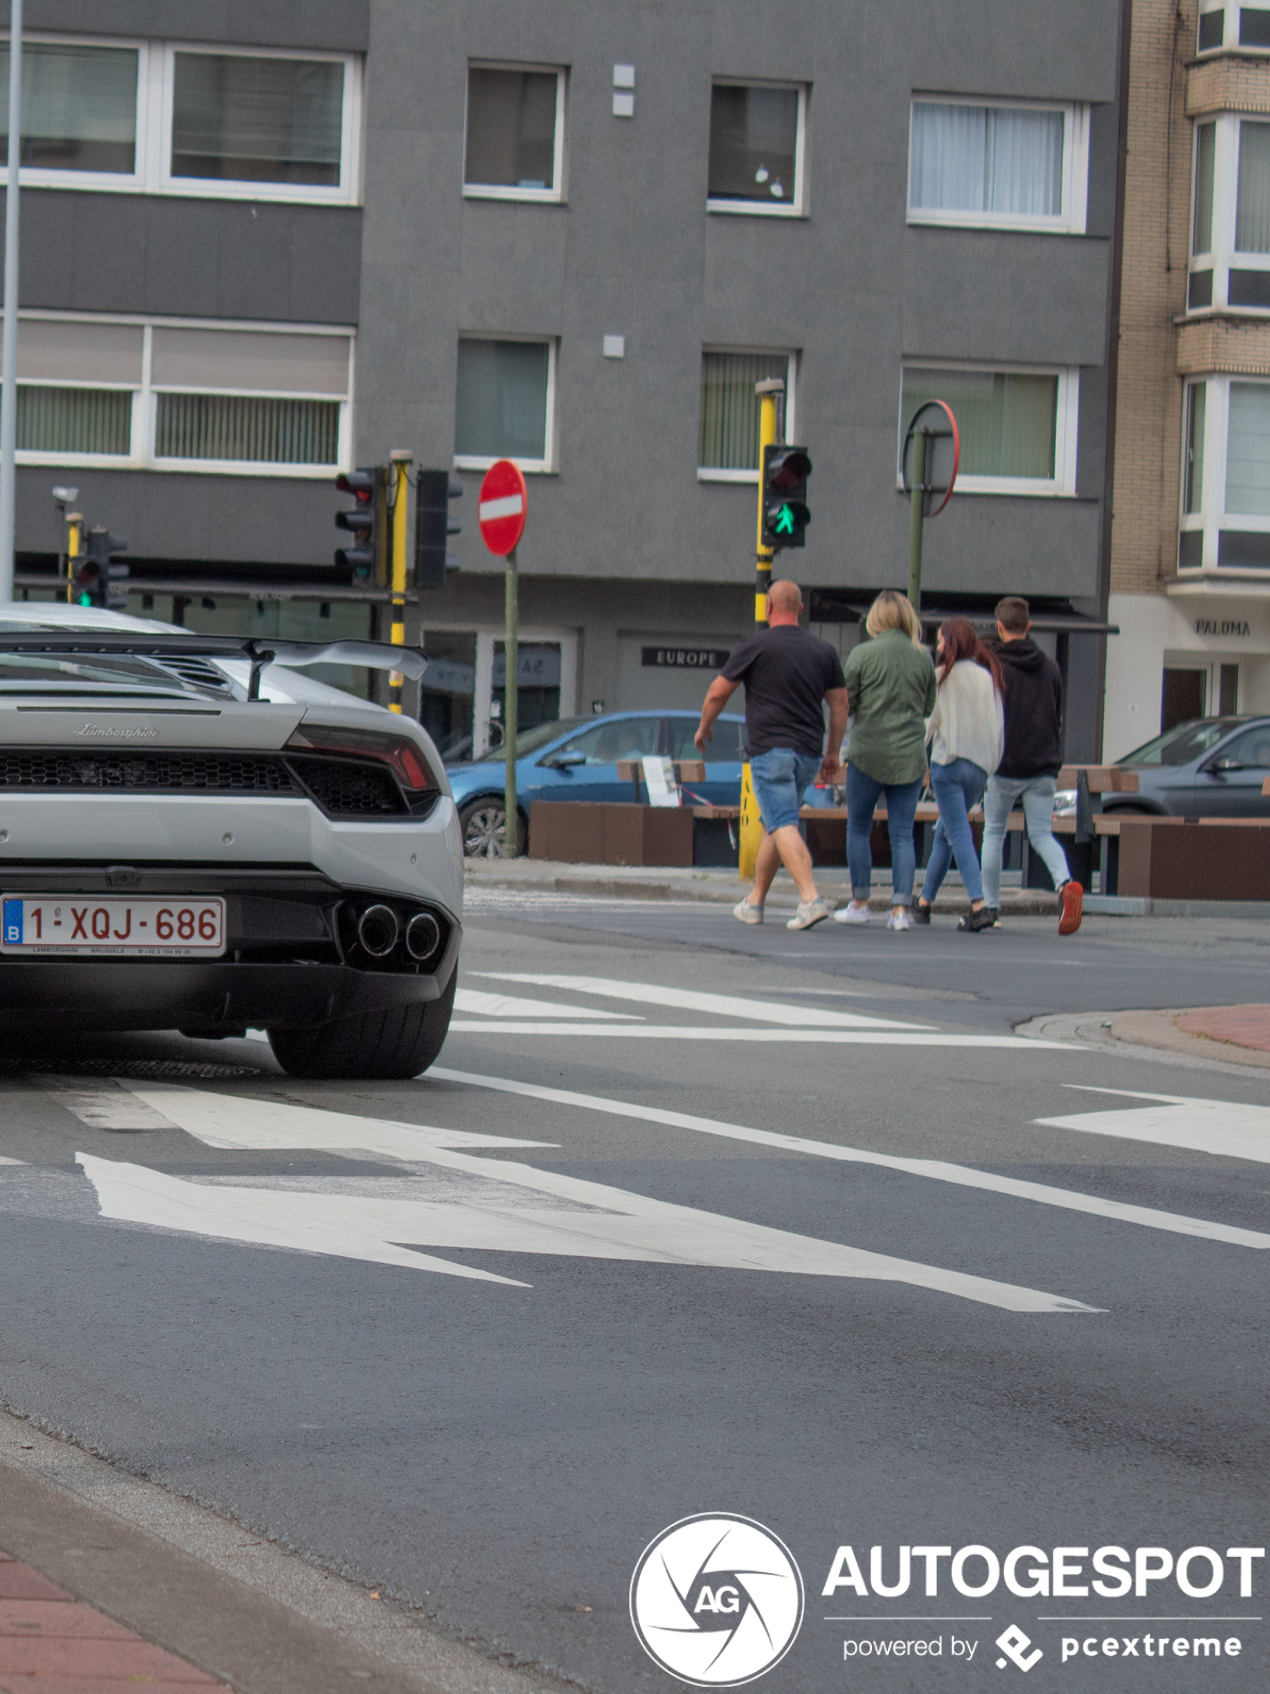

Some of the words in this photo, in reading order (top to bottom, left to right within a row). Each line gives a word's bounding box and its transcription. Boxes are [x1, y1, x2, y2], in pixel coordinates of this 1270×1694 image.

[1195, 620, 1250, 636] PALOMA
[656, 651, 716, 667] EUROPE
[73, 723, 159, 738] Lamborghini
[7, 926, 20, 941] B
[30, 907, 217, 941] 1-XQJ-686
